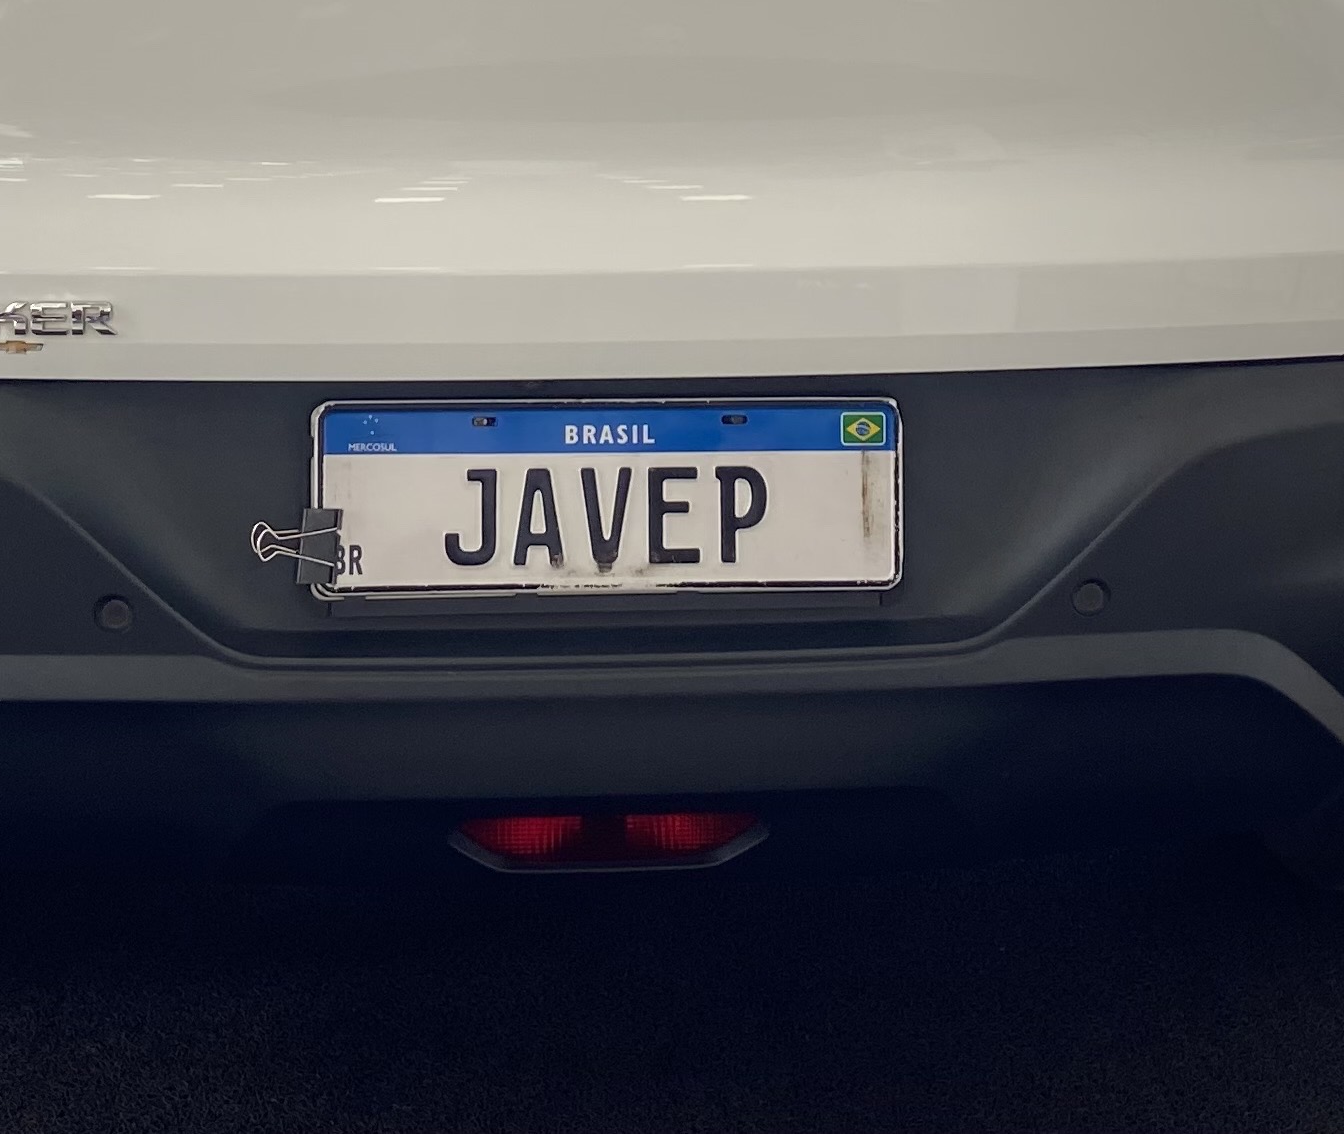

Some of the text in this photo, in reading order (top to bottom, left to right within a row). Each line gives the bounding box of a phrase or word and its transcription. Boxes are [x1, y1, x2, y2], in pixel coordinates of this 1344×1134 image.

[564, 424, 655, 445] BRASIL
[348, 442, 397, 452] MERCOSUL
[444, 466, 768, 567] JAVEP
